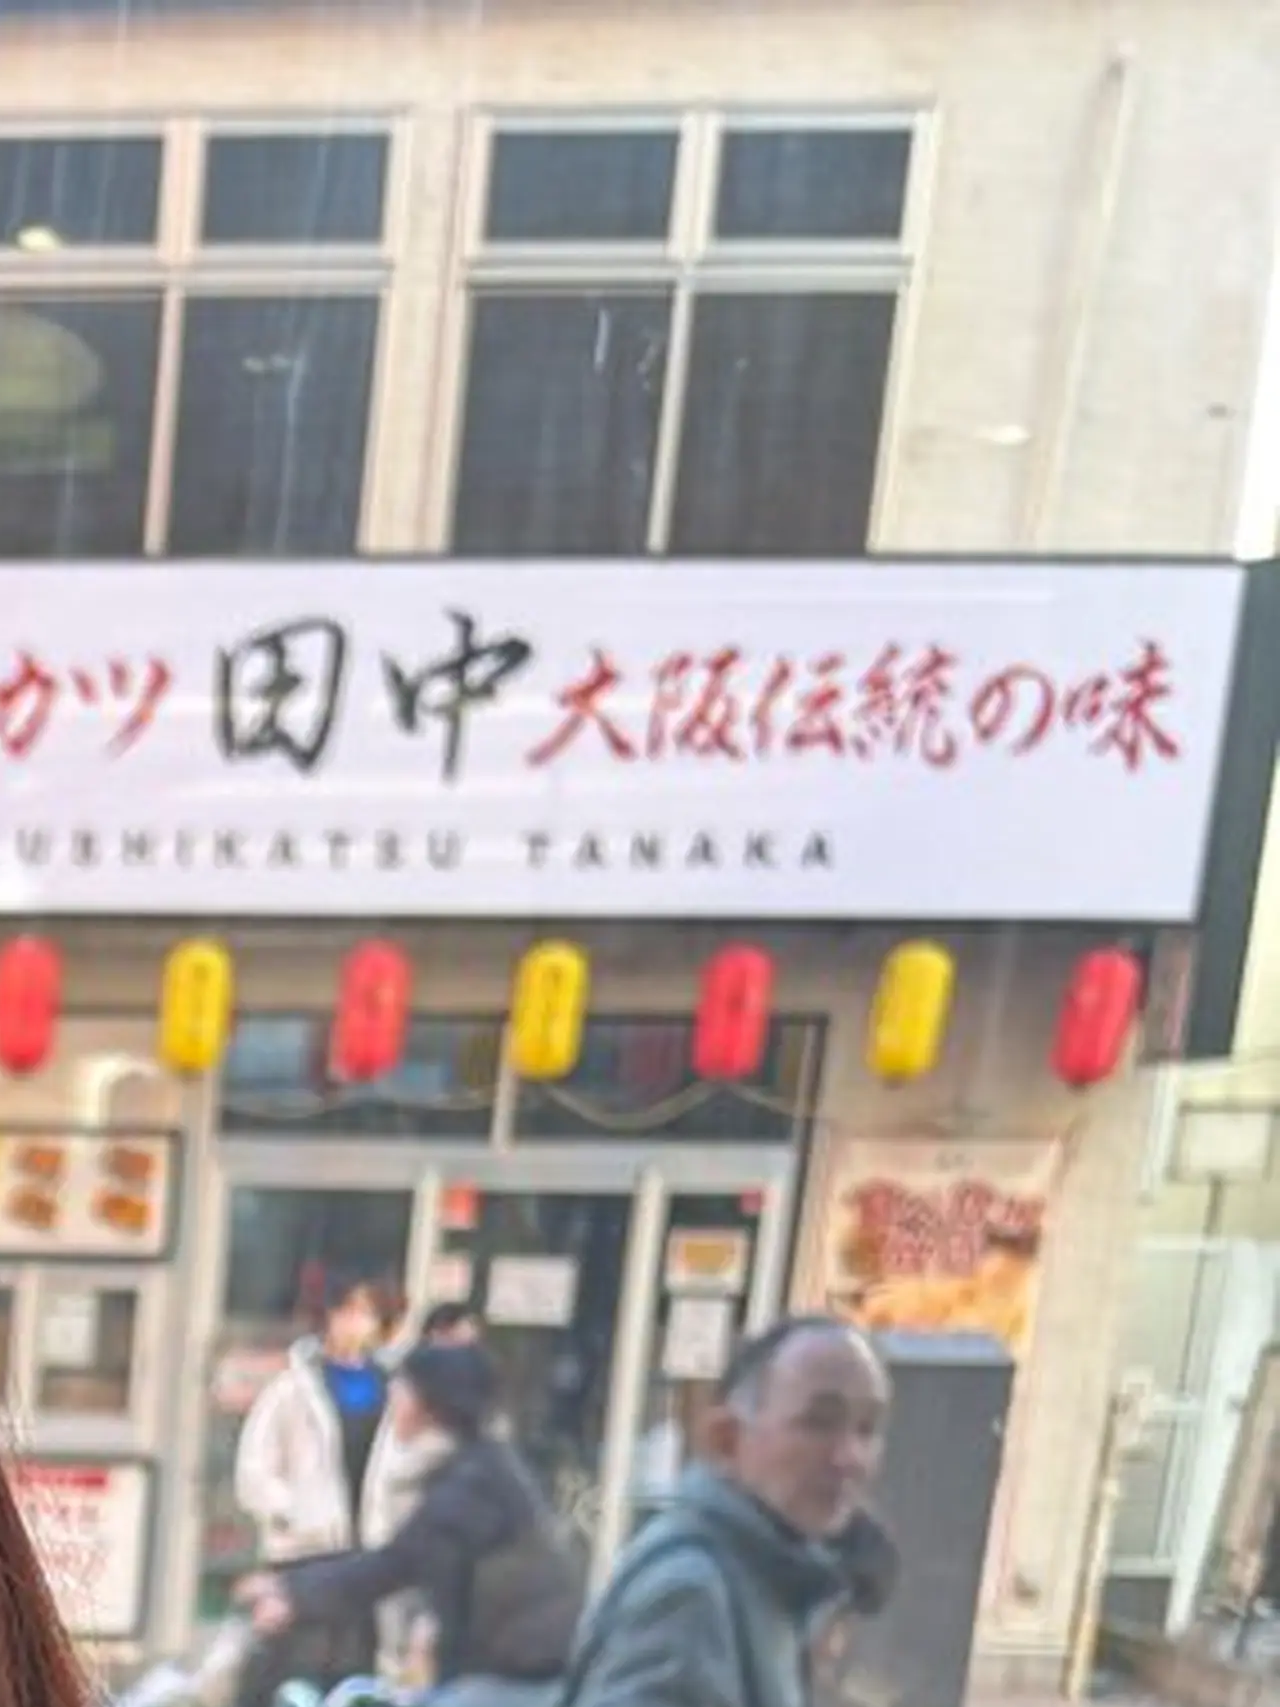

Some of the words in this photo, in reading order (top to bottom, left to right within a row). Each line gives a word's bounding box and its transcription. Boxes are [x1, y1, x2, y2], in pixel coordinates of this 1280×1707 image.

[214, 612, 532, 782] 田中
[526, 638, 1184, 772] 大阪伝統の味
[520, 828, 836, 869] TANAKA
